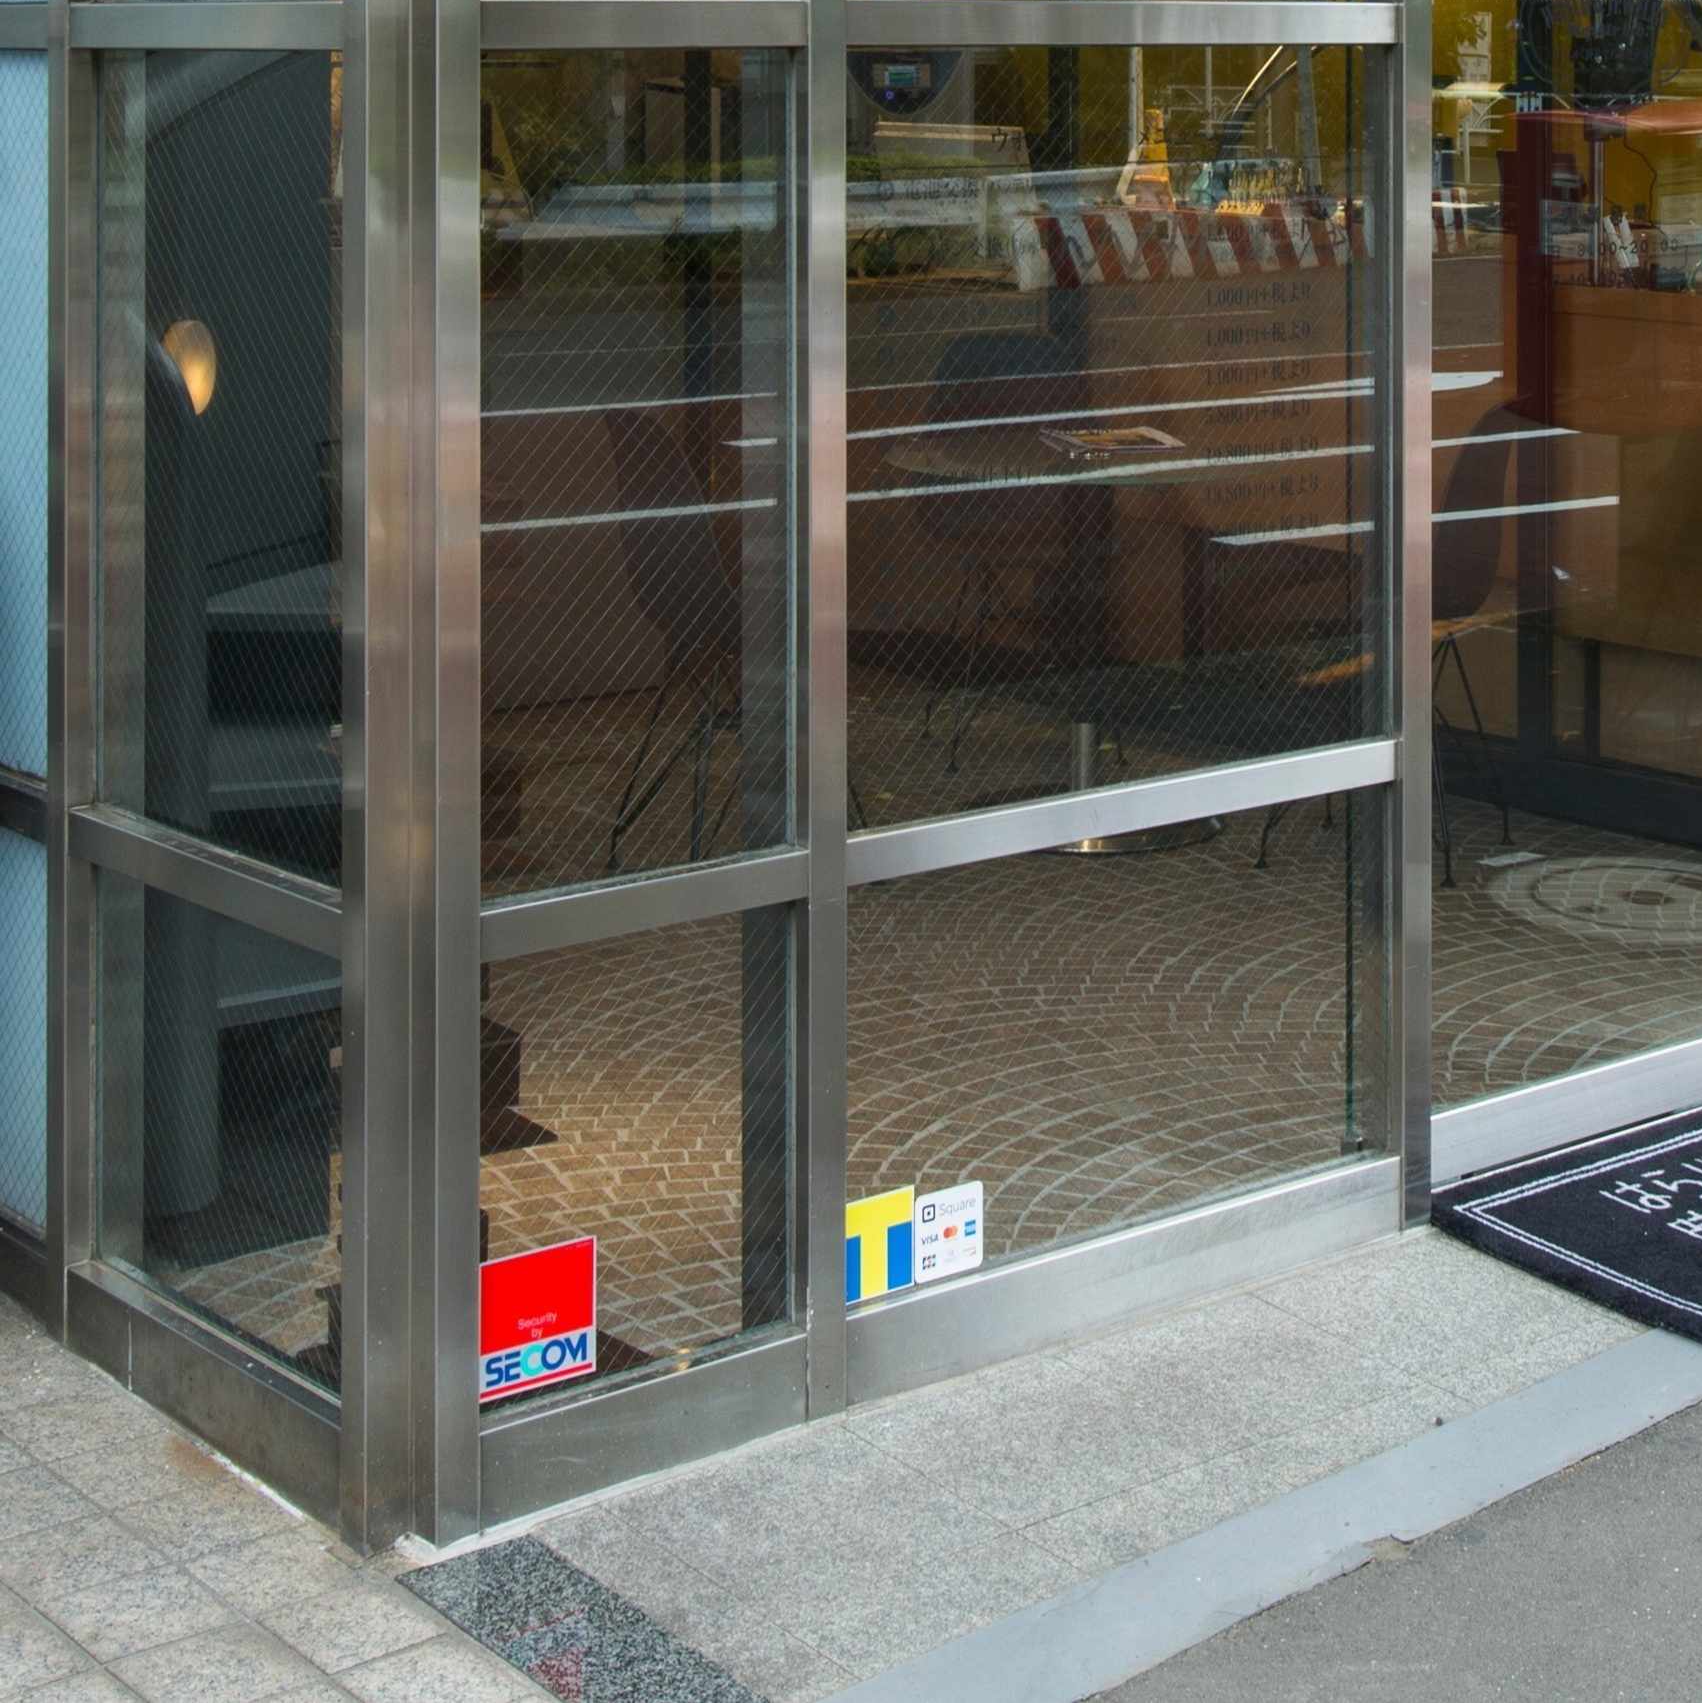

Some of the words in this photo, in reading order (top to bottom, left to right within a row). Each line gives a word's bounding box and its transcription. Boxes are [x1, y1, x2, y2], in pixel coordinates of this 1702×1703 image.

[938, 1199, 977, 1216] Square
[518, 1311, 558, 1330] Security
[531, 1327, 544, 1340] by
[485, 1332, 588, 1388] SECOM
